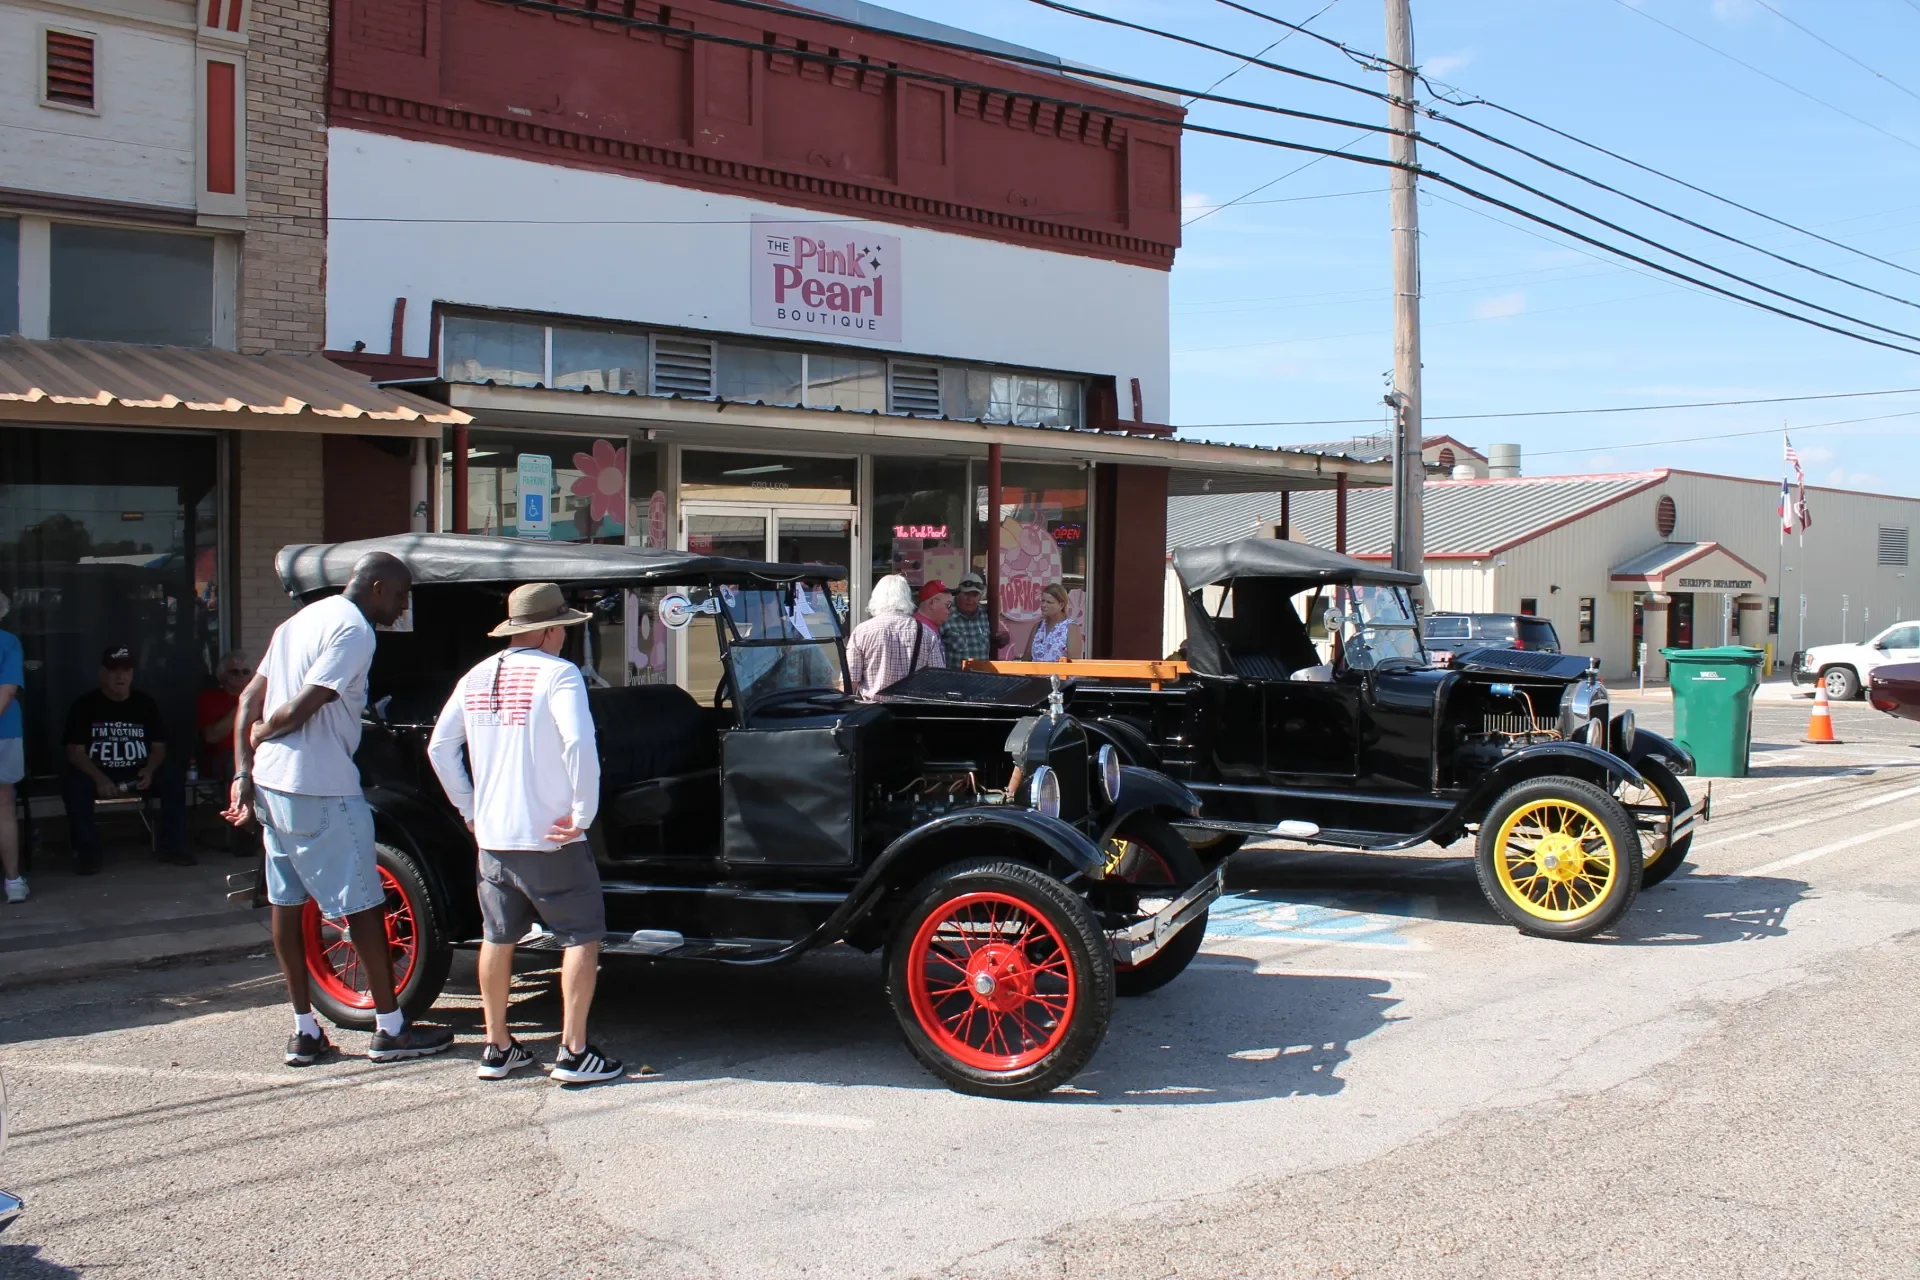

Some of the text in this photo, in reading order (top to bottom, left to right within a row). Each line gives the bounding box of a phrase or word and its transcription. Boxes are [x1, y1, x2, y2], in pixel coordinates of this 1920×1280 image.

[767, 235, 866, 279] THE Pink
[772, 263, 883, 317] Pearl
[777, 308, 877, 330] BOUTIQUE
[520, 462, 549, 474] RESERVED
[522, 475, 547, 487] PARKING
[893, 525, 947, 538] The Pink Pearl
[1053, 527, 1081, 540] OPEN
[690, 540, 710, 548] OPEN
[1679, 578, 1752, 589] SHERIFF'S DEPARTMENT
[502, 711, 527, 726] LIFE
[91, 727, 145, 738] I'M VOTING
[89, 740, 148, 761] FELON
[108, 760, 132, 768] 2024
